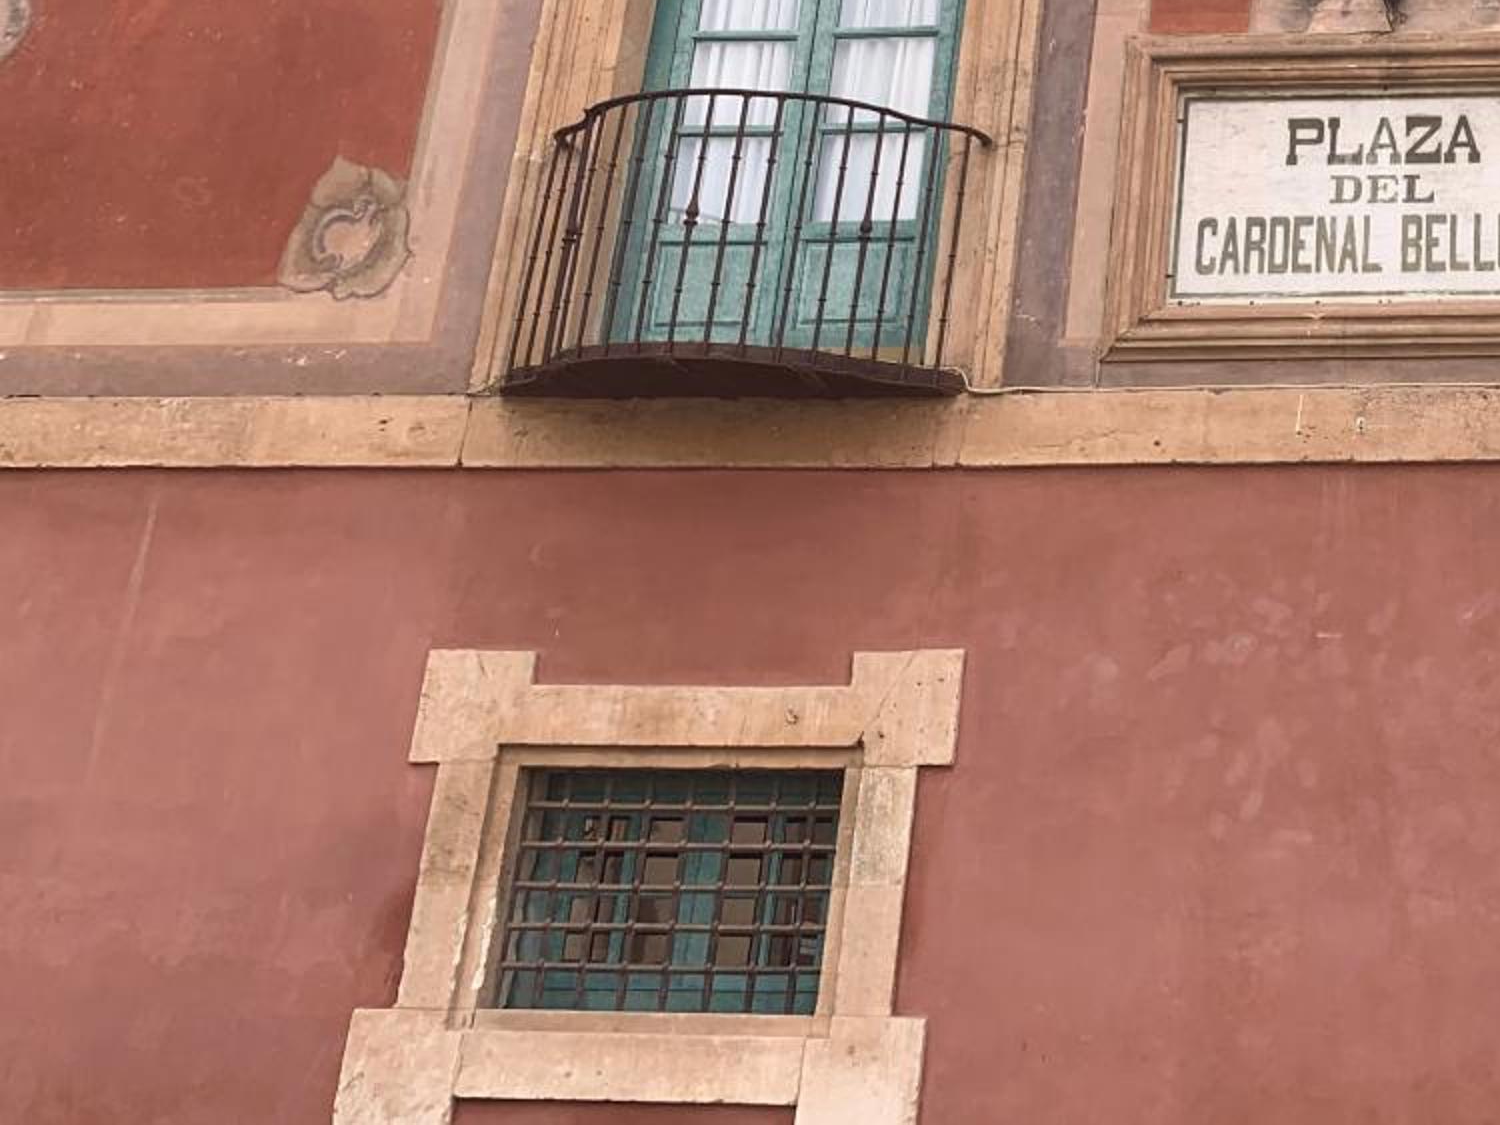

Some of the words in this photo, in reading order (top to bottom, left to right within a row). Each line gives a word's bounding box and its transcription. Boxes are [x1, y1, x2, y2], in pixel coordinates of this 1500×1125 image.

[1286, 115, 1480, 165] PLAZA
[1329, 174, 1435, 204] DEL
[1195, 215, 1382, 275] CARDENAL
